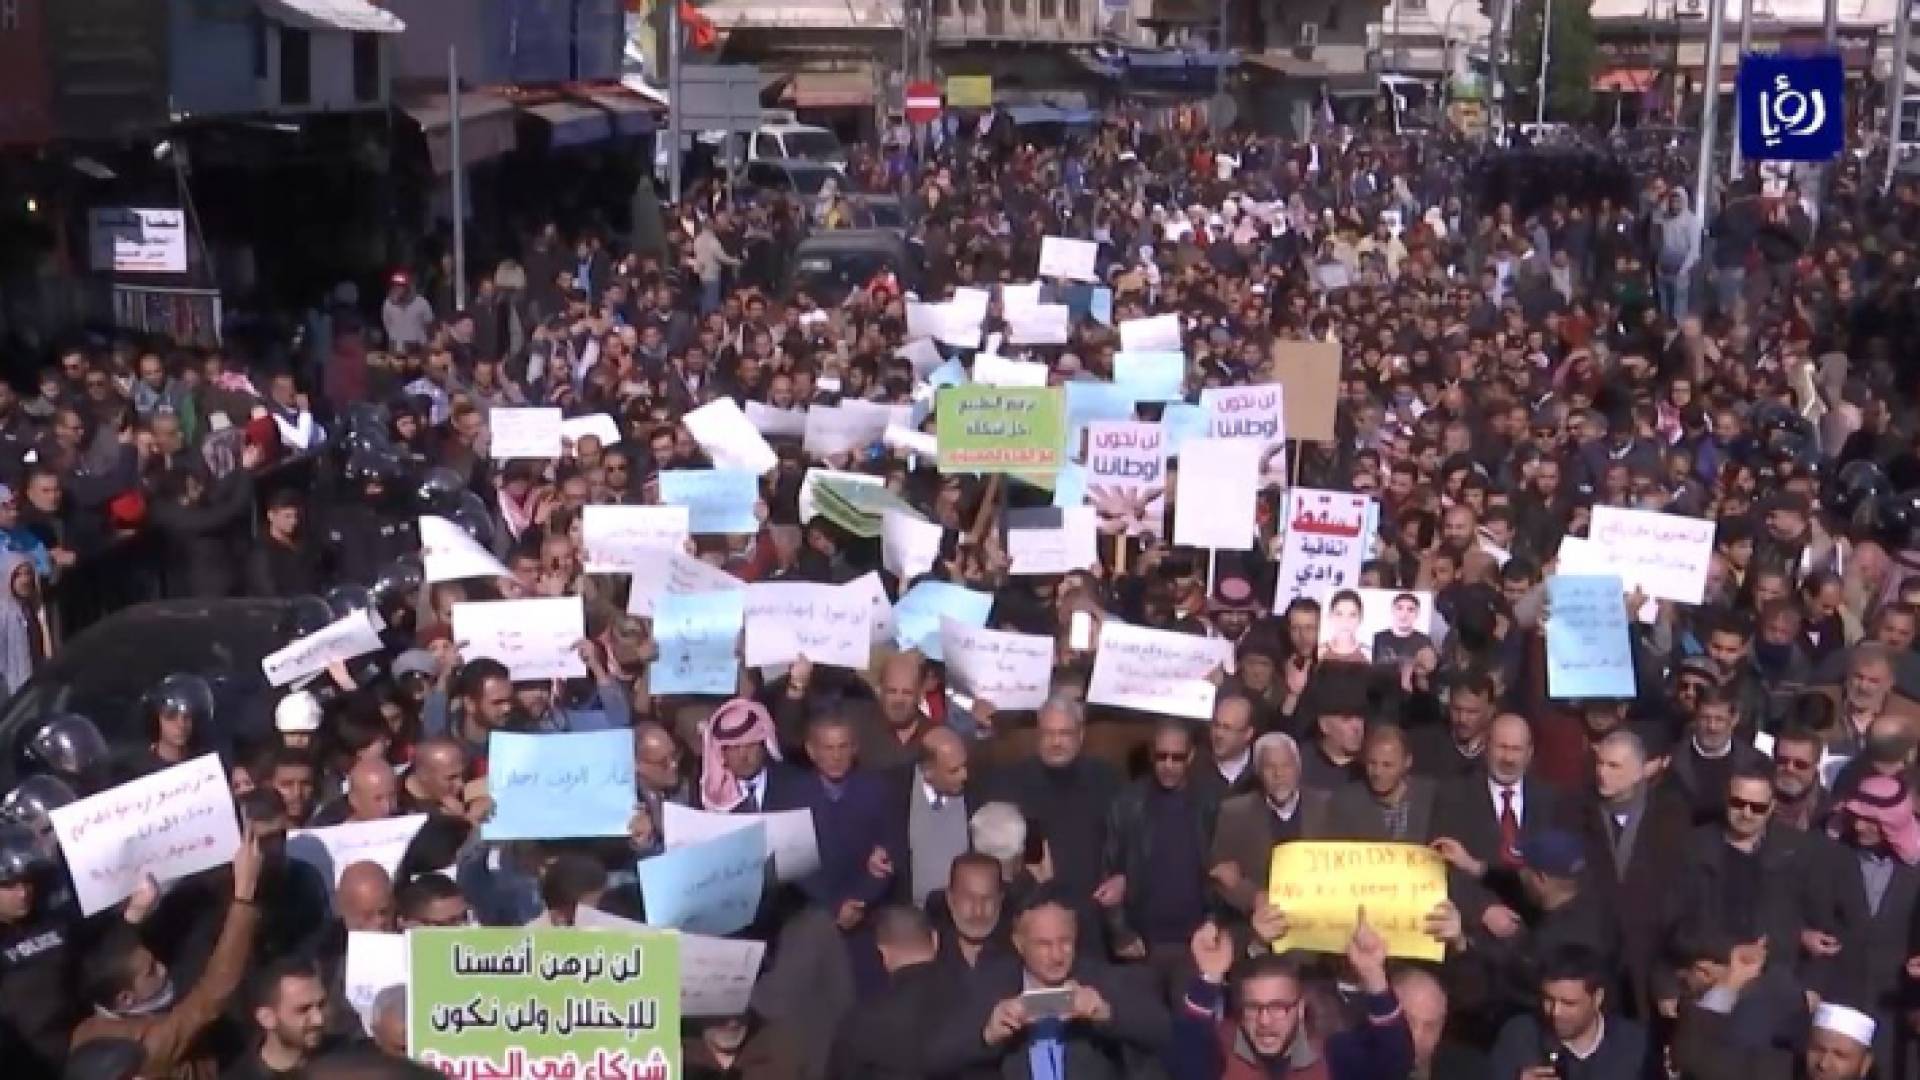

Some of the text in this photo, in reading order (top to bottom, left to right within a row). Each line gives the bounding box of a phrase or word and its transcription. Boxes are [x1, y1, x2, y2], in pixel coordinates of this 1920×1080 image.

[1291, 496, 1363, 537] تسقط
[1295, 564, 1343, 587] وادي
[454, 936, 533, 976] أنفسنا
[540, 948, 604, 983] نرهن
[611, 948, 641, 983] لن
[431, 997, 656, 1037] للإحتلال ولن نكون
[424, 1050, 522, 1080] الجريم
